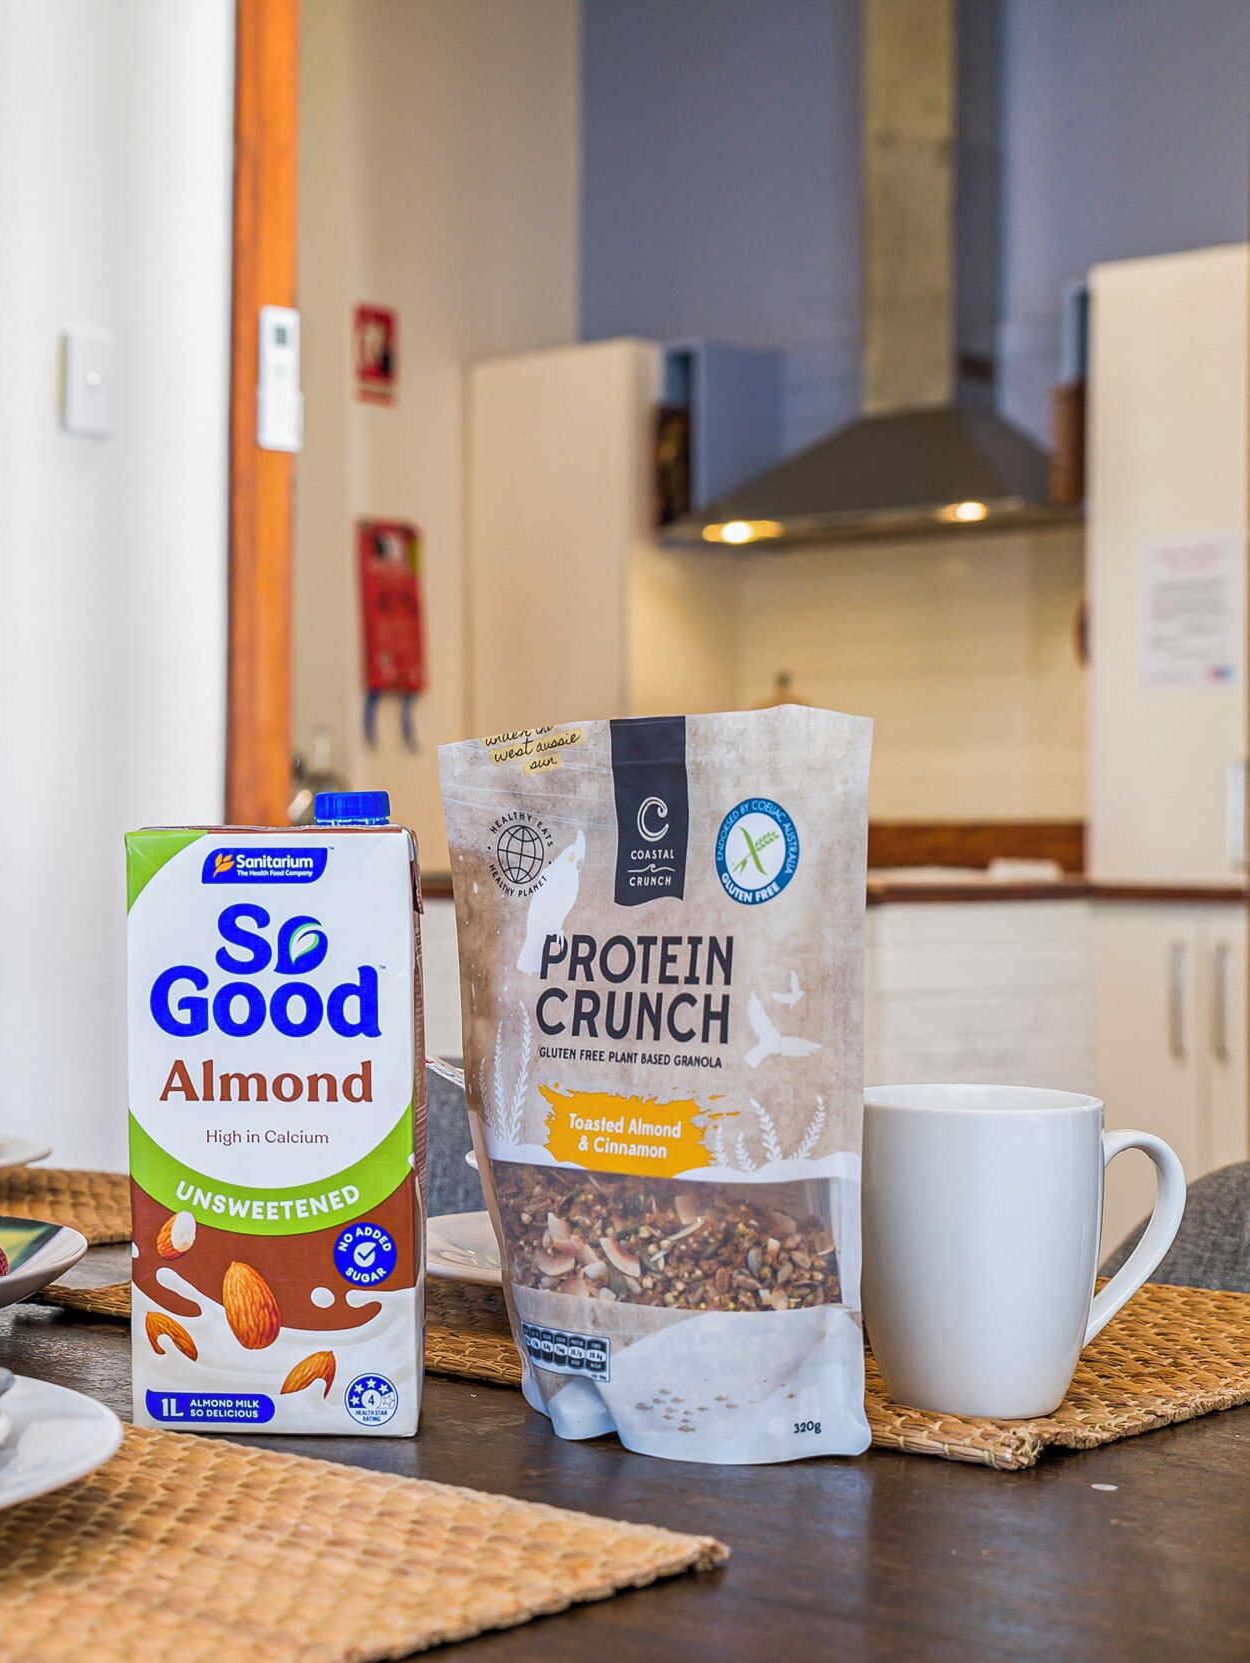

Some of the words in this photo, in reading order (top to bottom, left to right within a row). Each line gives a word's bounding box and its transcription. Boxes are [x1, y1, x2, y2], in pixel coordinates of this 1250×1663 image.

[494, 737, 533, 763] west
[536, 732, 580, 752] aussie
[530, 757, 558, 770] sun.
[489, 811, 532, 834] HEALTHY
[536, 820, 554, 847] EATS
[716, 810, 740, 861] ENDORSED
[739, 802, 750, 814] BY
[751, 799, 787, 822] COELIAC
[782, 822, 798, 874] AUSTRALIA
[236, 854, 313, 869] Sanitarium
[630, 849, 675, 860] COASTAL
[286, 870, 313, 878] Company
[488, 863, 515, 897] HEALTHY
[518, 875, 548, 898] PLANET
[629, 876, 672, 887] CRUNCH
[721, 872, 753, 903] GLUTEN
[755, 881, 780, 902] FREE
[215, 902, 329, 975] So
[539, 933, 735, 986] PROTEIN
[149, 964, 383, 1039] Good
[535, 987, 730, 1044] CRUNCH
[539, 1046, 576, 1061] GLUTEN
[579, 1049, 605, 1062] FREE
[608, 1051, 638, 1064] PLANT
[641, 1052, 670, 1066] BASED
[673, 1054, 722, 1069] GRANOLA
[159, 1059, 373, 1103] Almond
[569, 1112, 625, 1134] Toasted
[628, 1117, 681, 1139] Almond
[206, 1130, 242, 1147] High
[246, 1130, 260, 1143] in
[264, 1130, 329, 1144] Calcium
[578, 1134, 589, 1151] &
[593, 1136, 667, 1159] Cinnamon
[176, 1180, 360, 1220] UNSWEETENED
[338, 1233, 353, 1252] NO
[355, 1226, 392, 1252] ADDED
[345, 1267, 387, 1283] SUGAR
[161, 1398, 184, 1417] 1L
[190, 1399, 233, 1408] ALMOND
[235, 1399, 260, 1408] MILK
[367, 1394, 375, 1406] 4
[190, 1409, 204, 1417] SO
[206, 1409, 258, 1418] DELICIOUS
[793, 1420, 822, 1435] 320g
